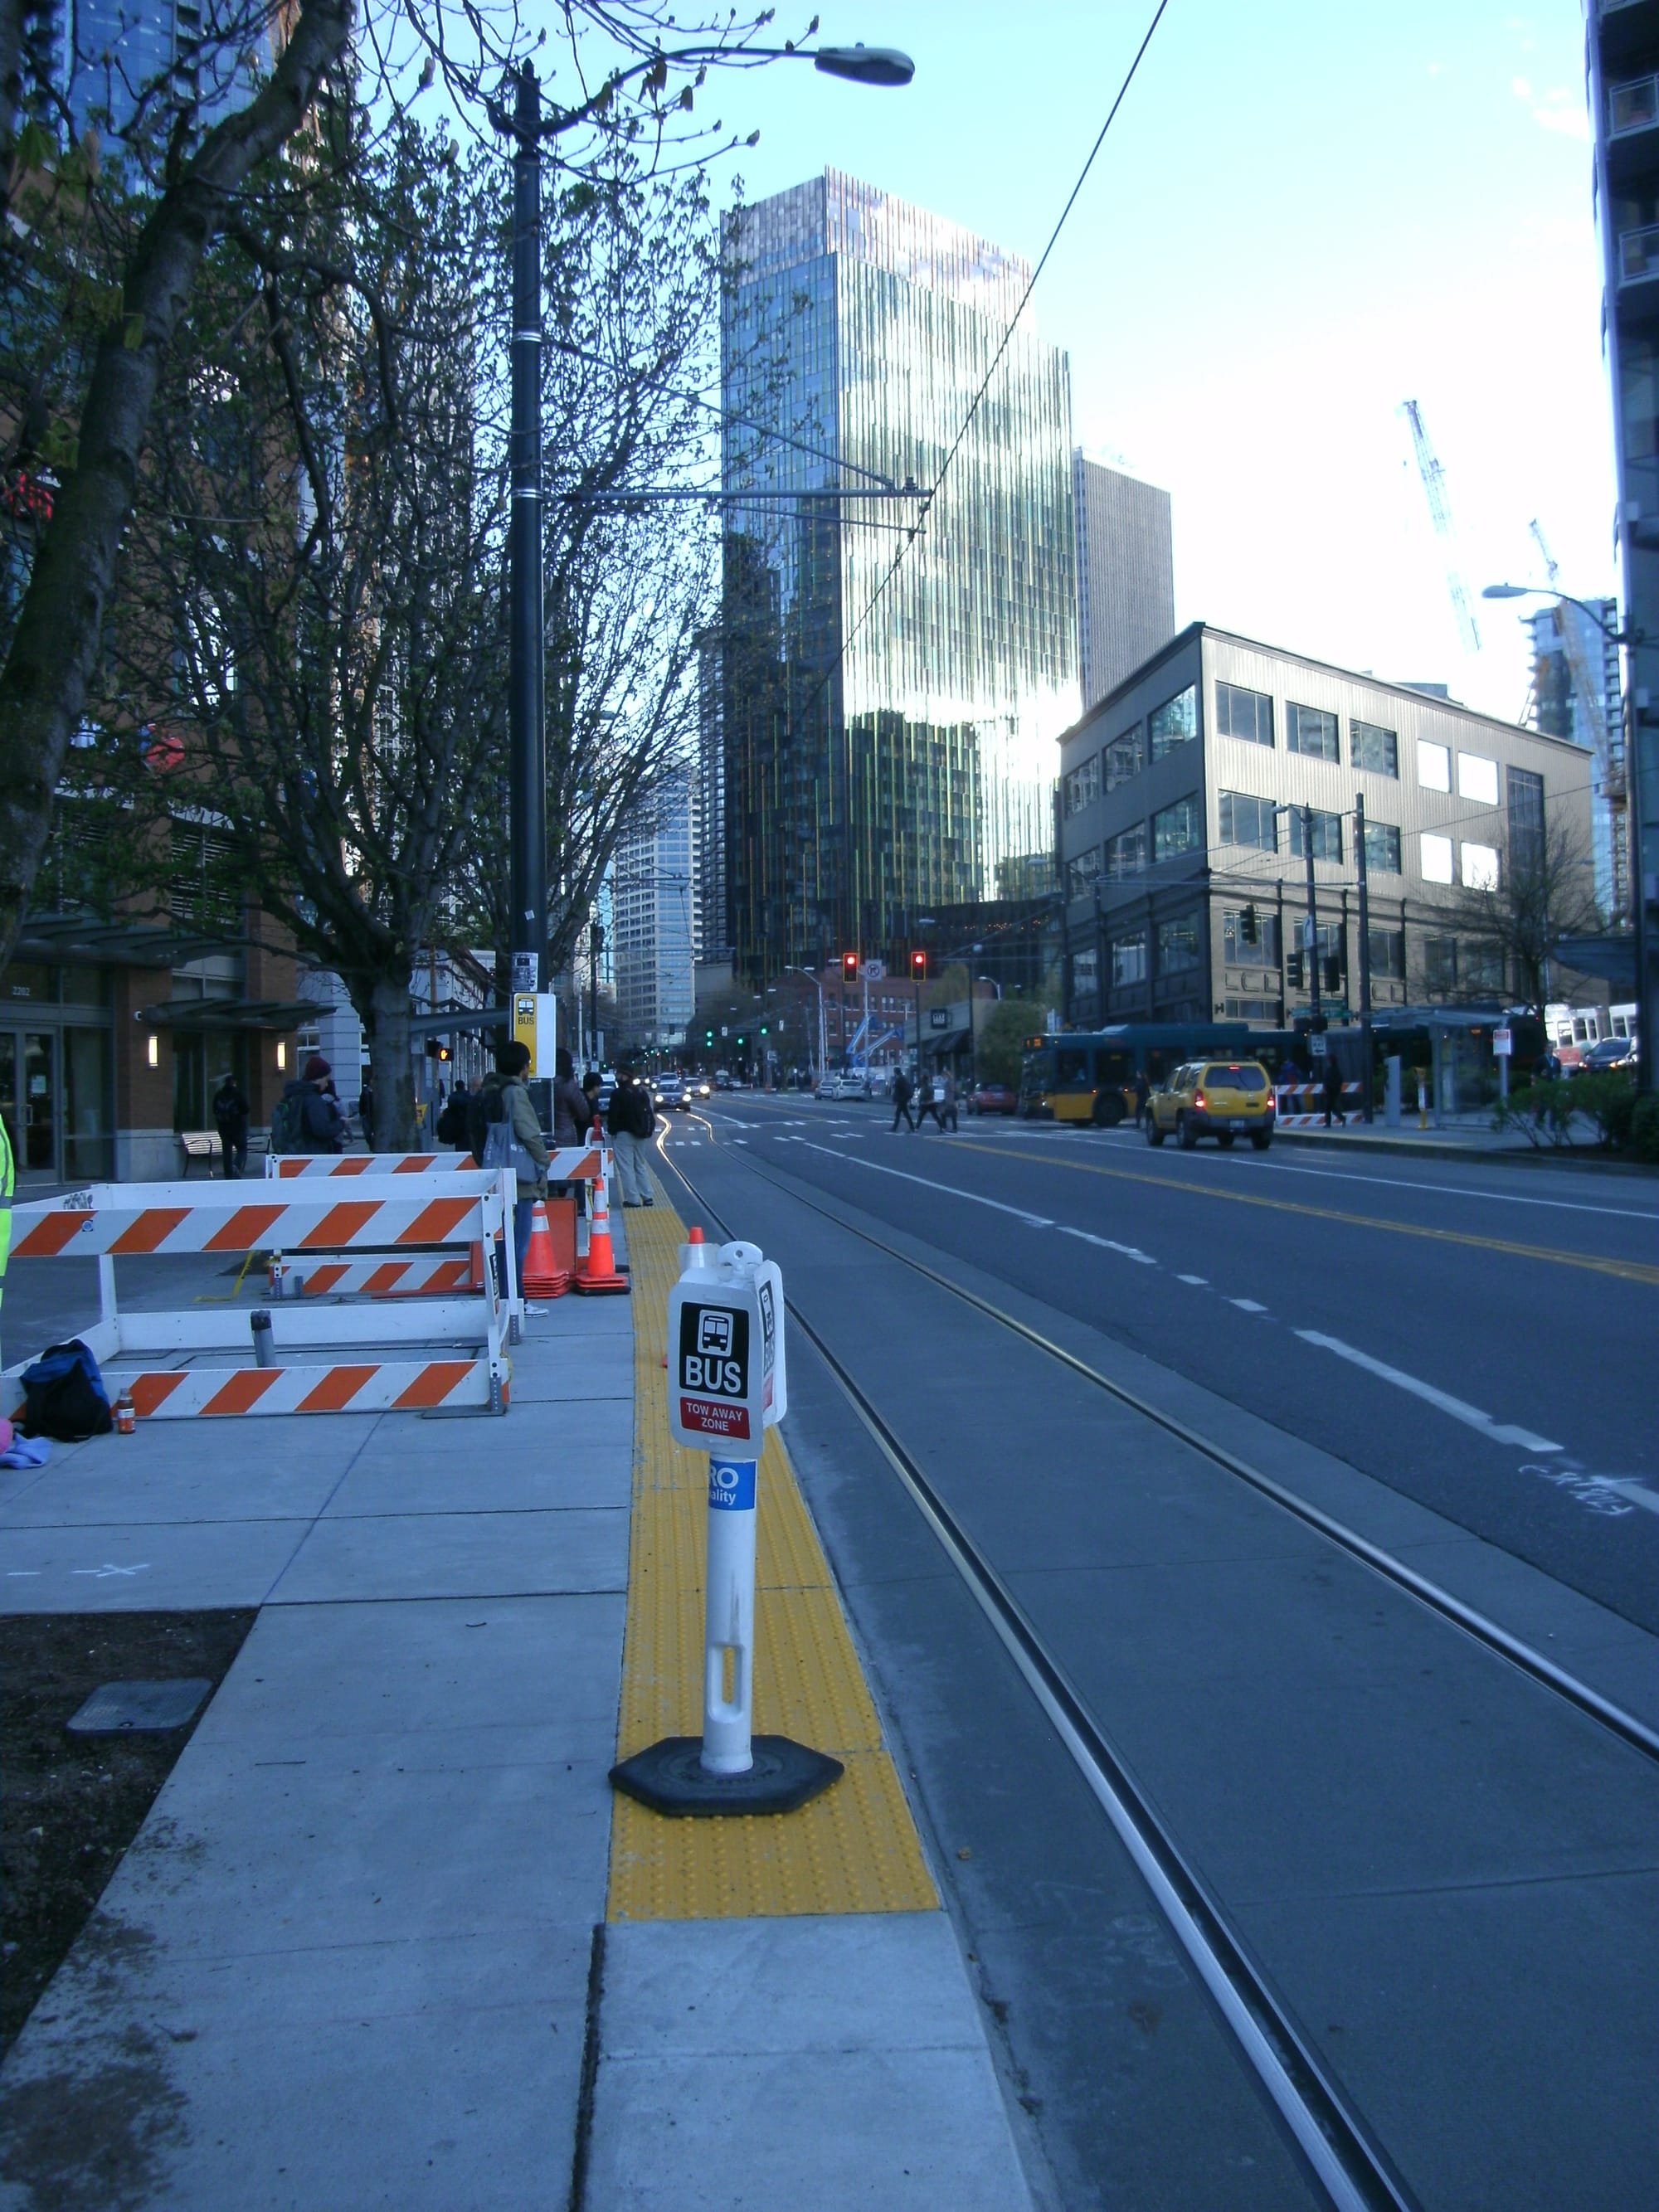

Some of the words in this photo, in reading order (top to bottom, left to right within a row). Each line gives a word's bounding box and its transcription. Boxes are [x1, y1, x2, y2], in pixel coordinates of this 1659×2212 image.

[518, 1017, 534, 1025] BUS
[685, 1354, 742, 1393] BUS
[686, 1402, 709, 1416] TOW
[712, 1407, 742, 1422] AWAY
[701, 1417, 730, 1432] ZONE
